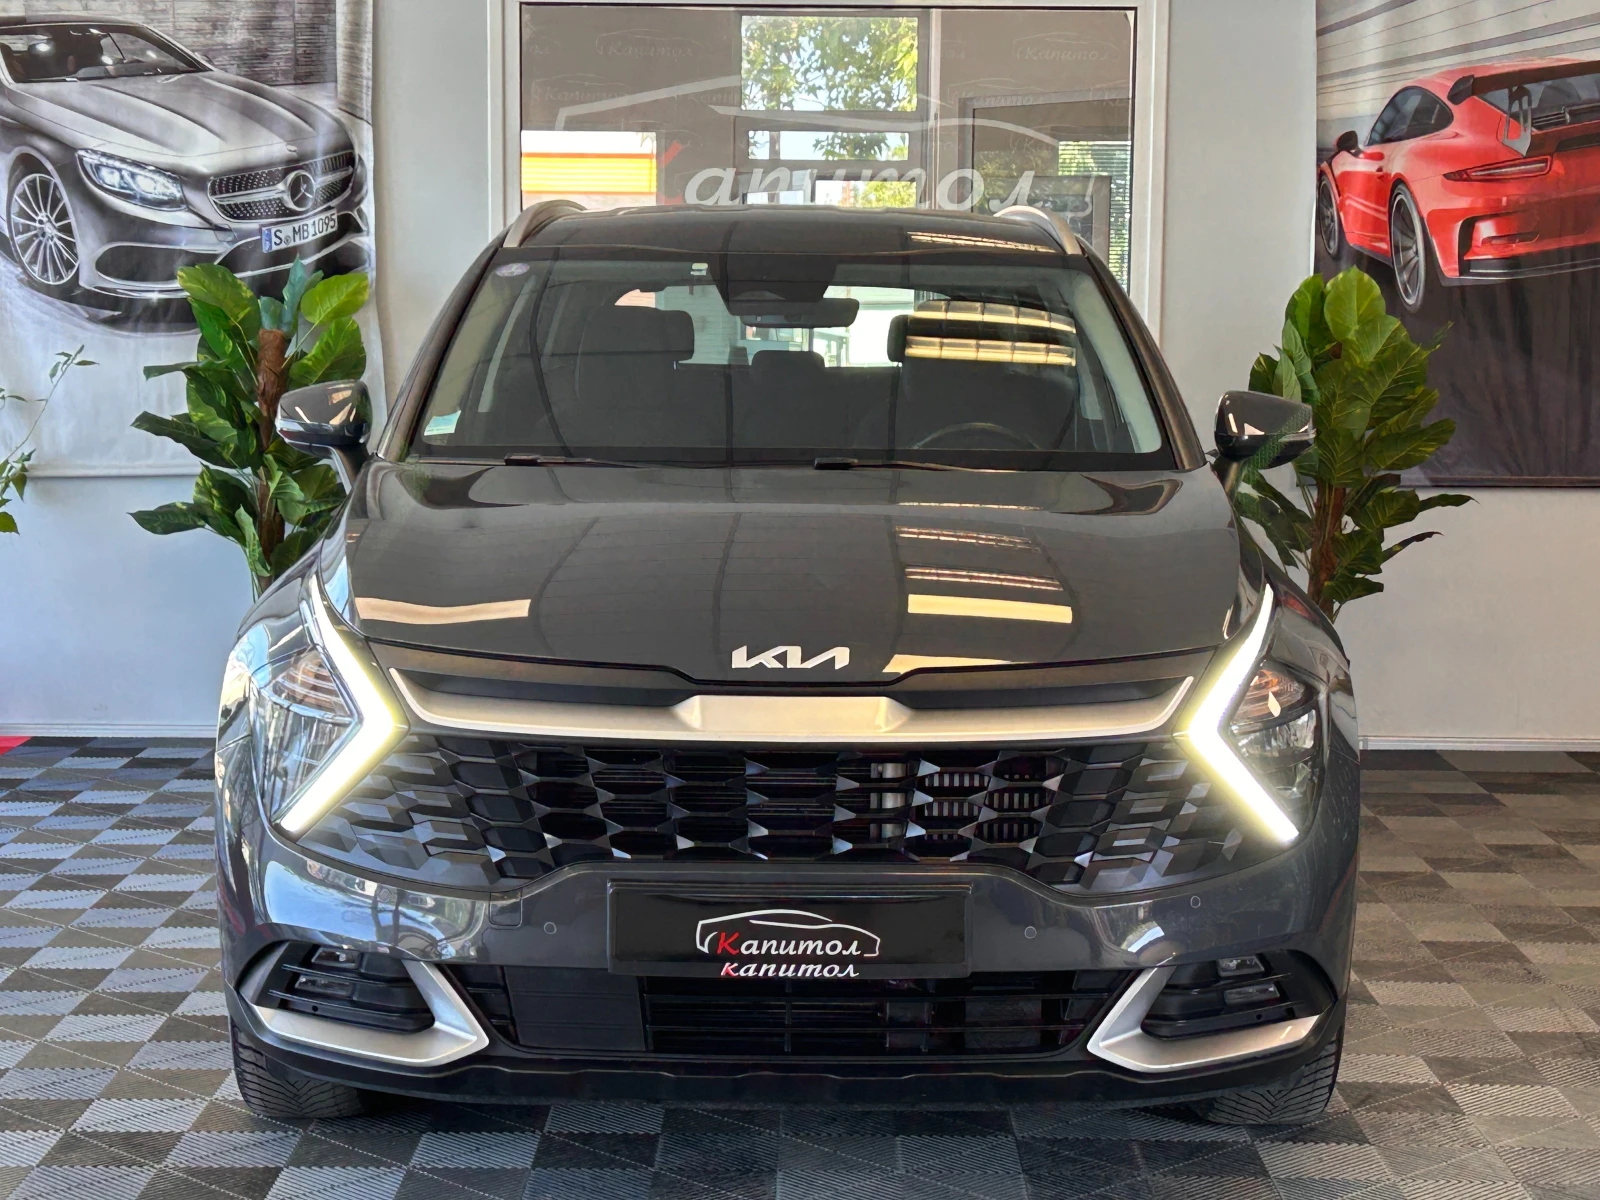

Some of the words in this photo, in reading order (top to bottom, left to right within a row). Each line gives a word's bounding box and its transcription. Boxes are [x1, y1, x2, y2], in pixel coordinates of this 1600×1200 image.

[273, 229, 283, 246] S
[292, 223, 309, 243] MB
[312, 212, 336, 237] 1095
